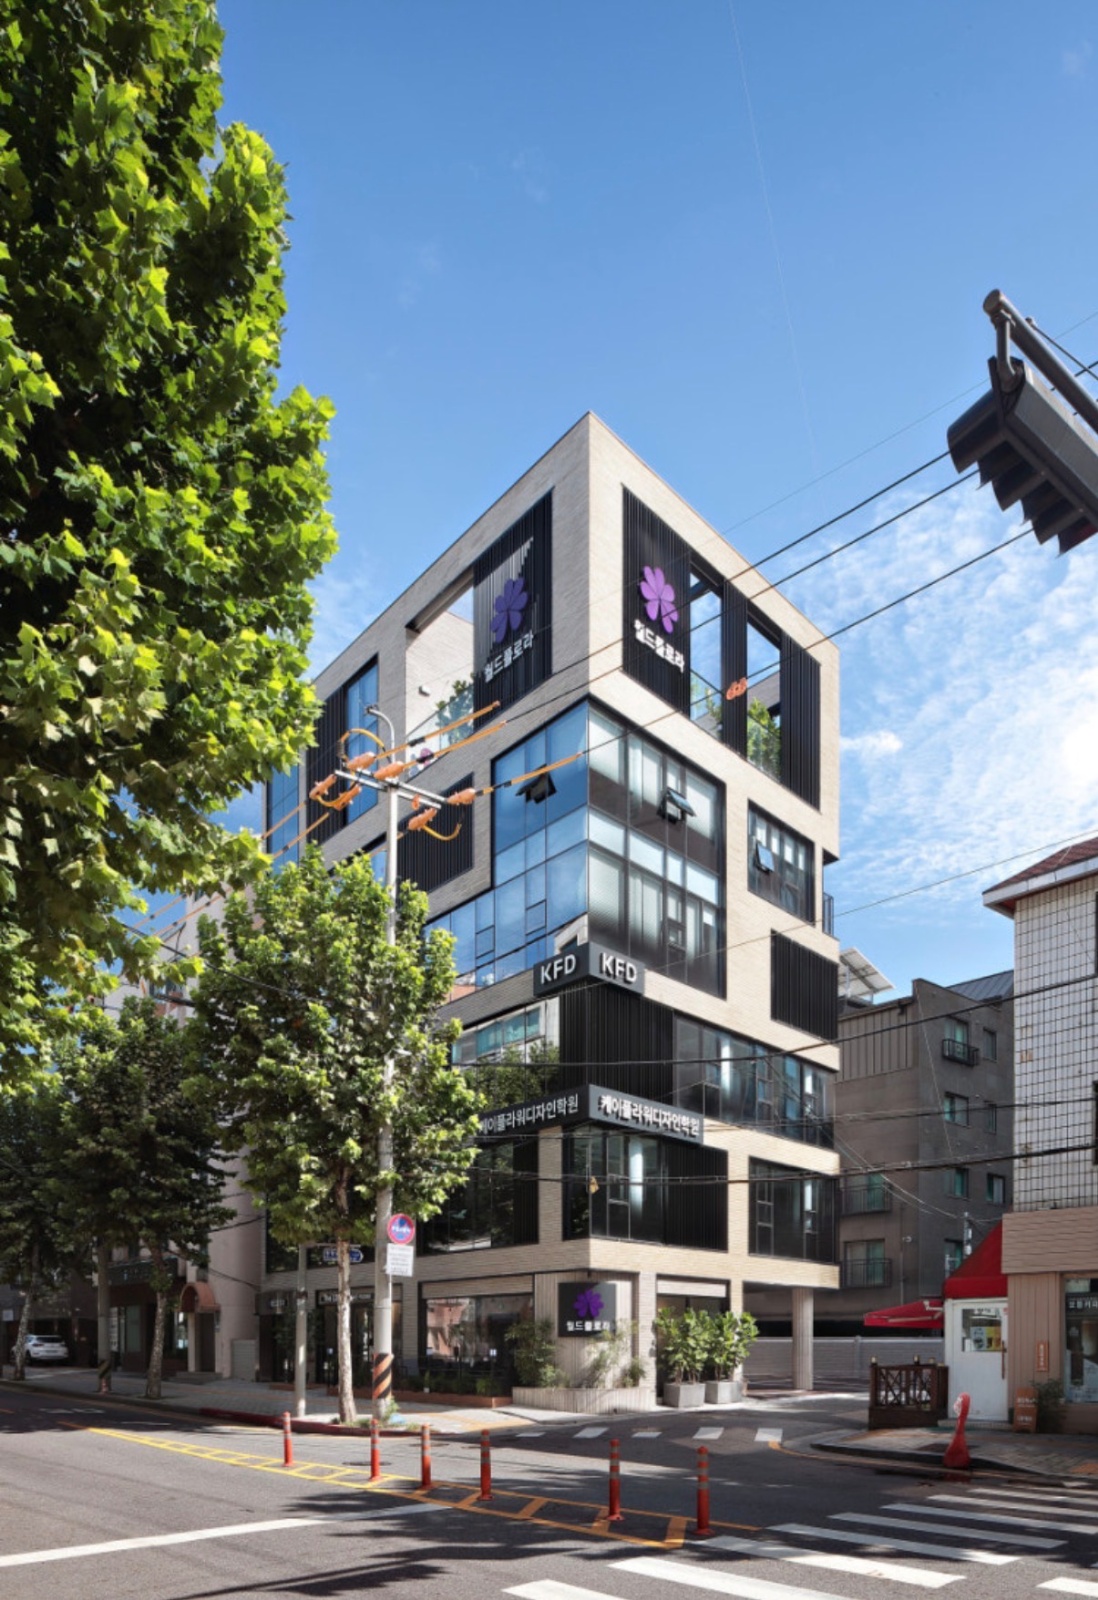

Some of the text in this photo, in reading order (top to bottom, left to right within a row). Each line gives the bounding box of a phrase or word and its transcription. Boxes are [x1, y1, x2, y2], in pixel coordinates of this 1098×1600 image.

[484, 629, 534, 683] 월드플로라
[634, 619, 685, 673] 월드플로라
[540, 954, 577, 984] KFD
[602, 952, 638, 982] KFD
[600, 1094, 700, 1136] 케이플라워디자인학원
